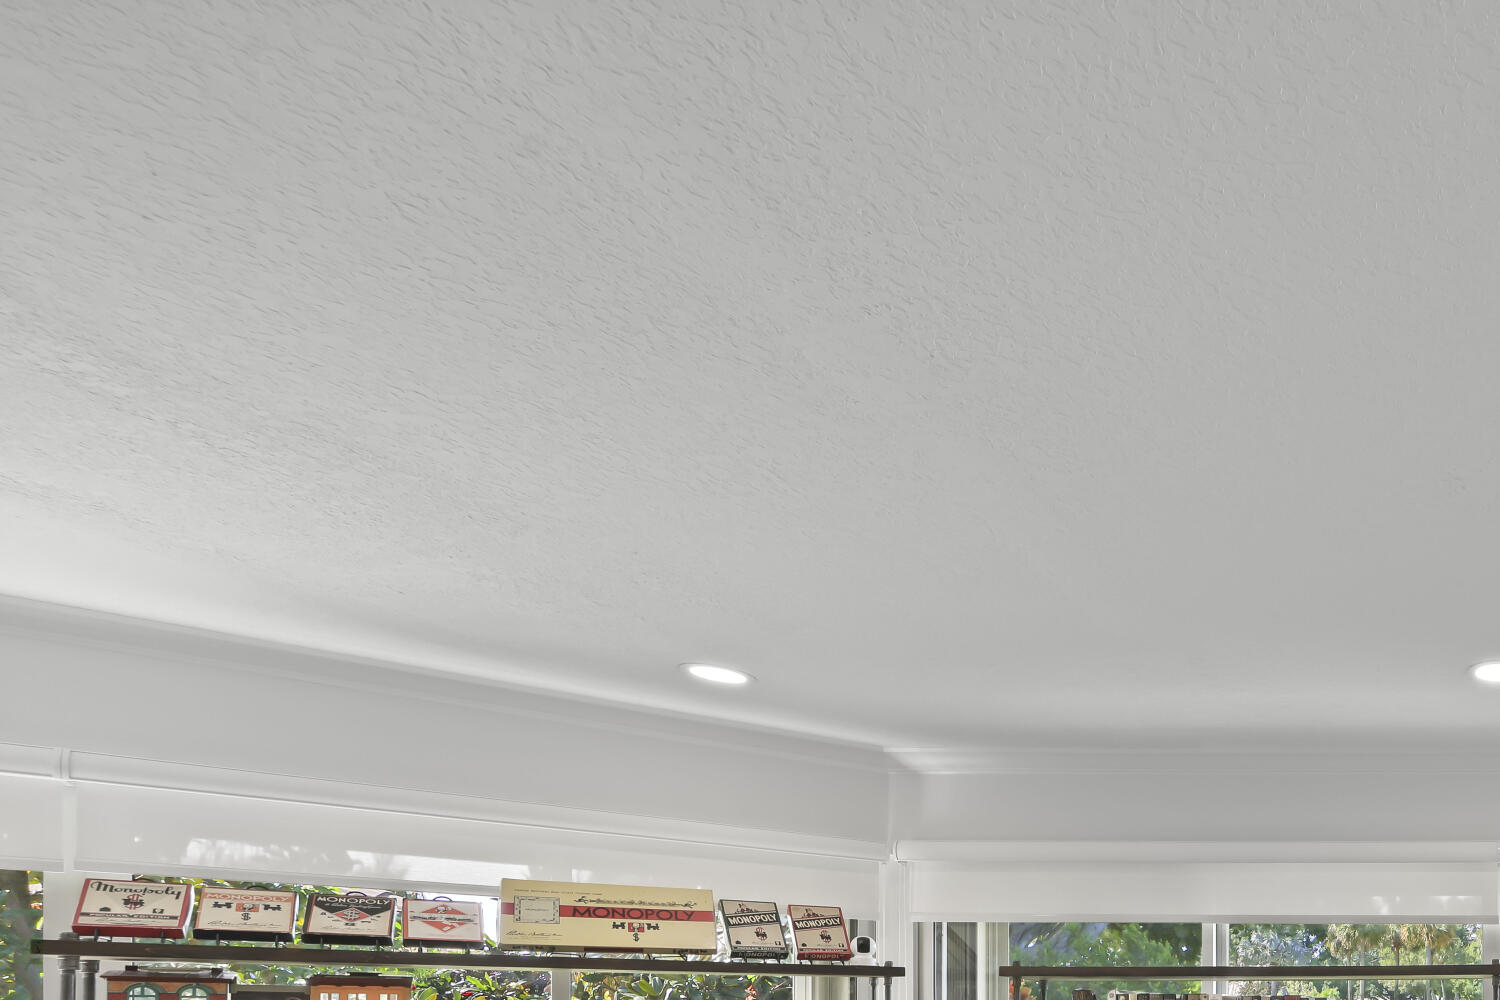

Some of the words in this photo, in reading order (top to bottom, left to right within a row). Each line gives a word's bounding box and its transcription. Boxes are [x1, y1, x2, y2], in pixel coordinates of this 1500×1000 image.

[90, 880, 183, 900] Monopoly
[205, 893, 289, 902] MONOPOLY
[316, 896, 391, 906] MONOPOLY
[572, 906, 695, 921] MONOPOLY
[727, 914, 777, 926] MONOPOLY
[794, 917, 841, 929] MONOPOLY
